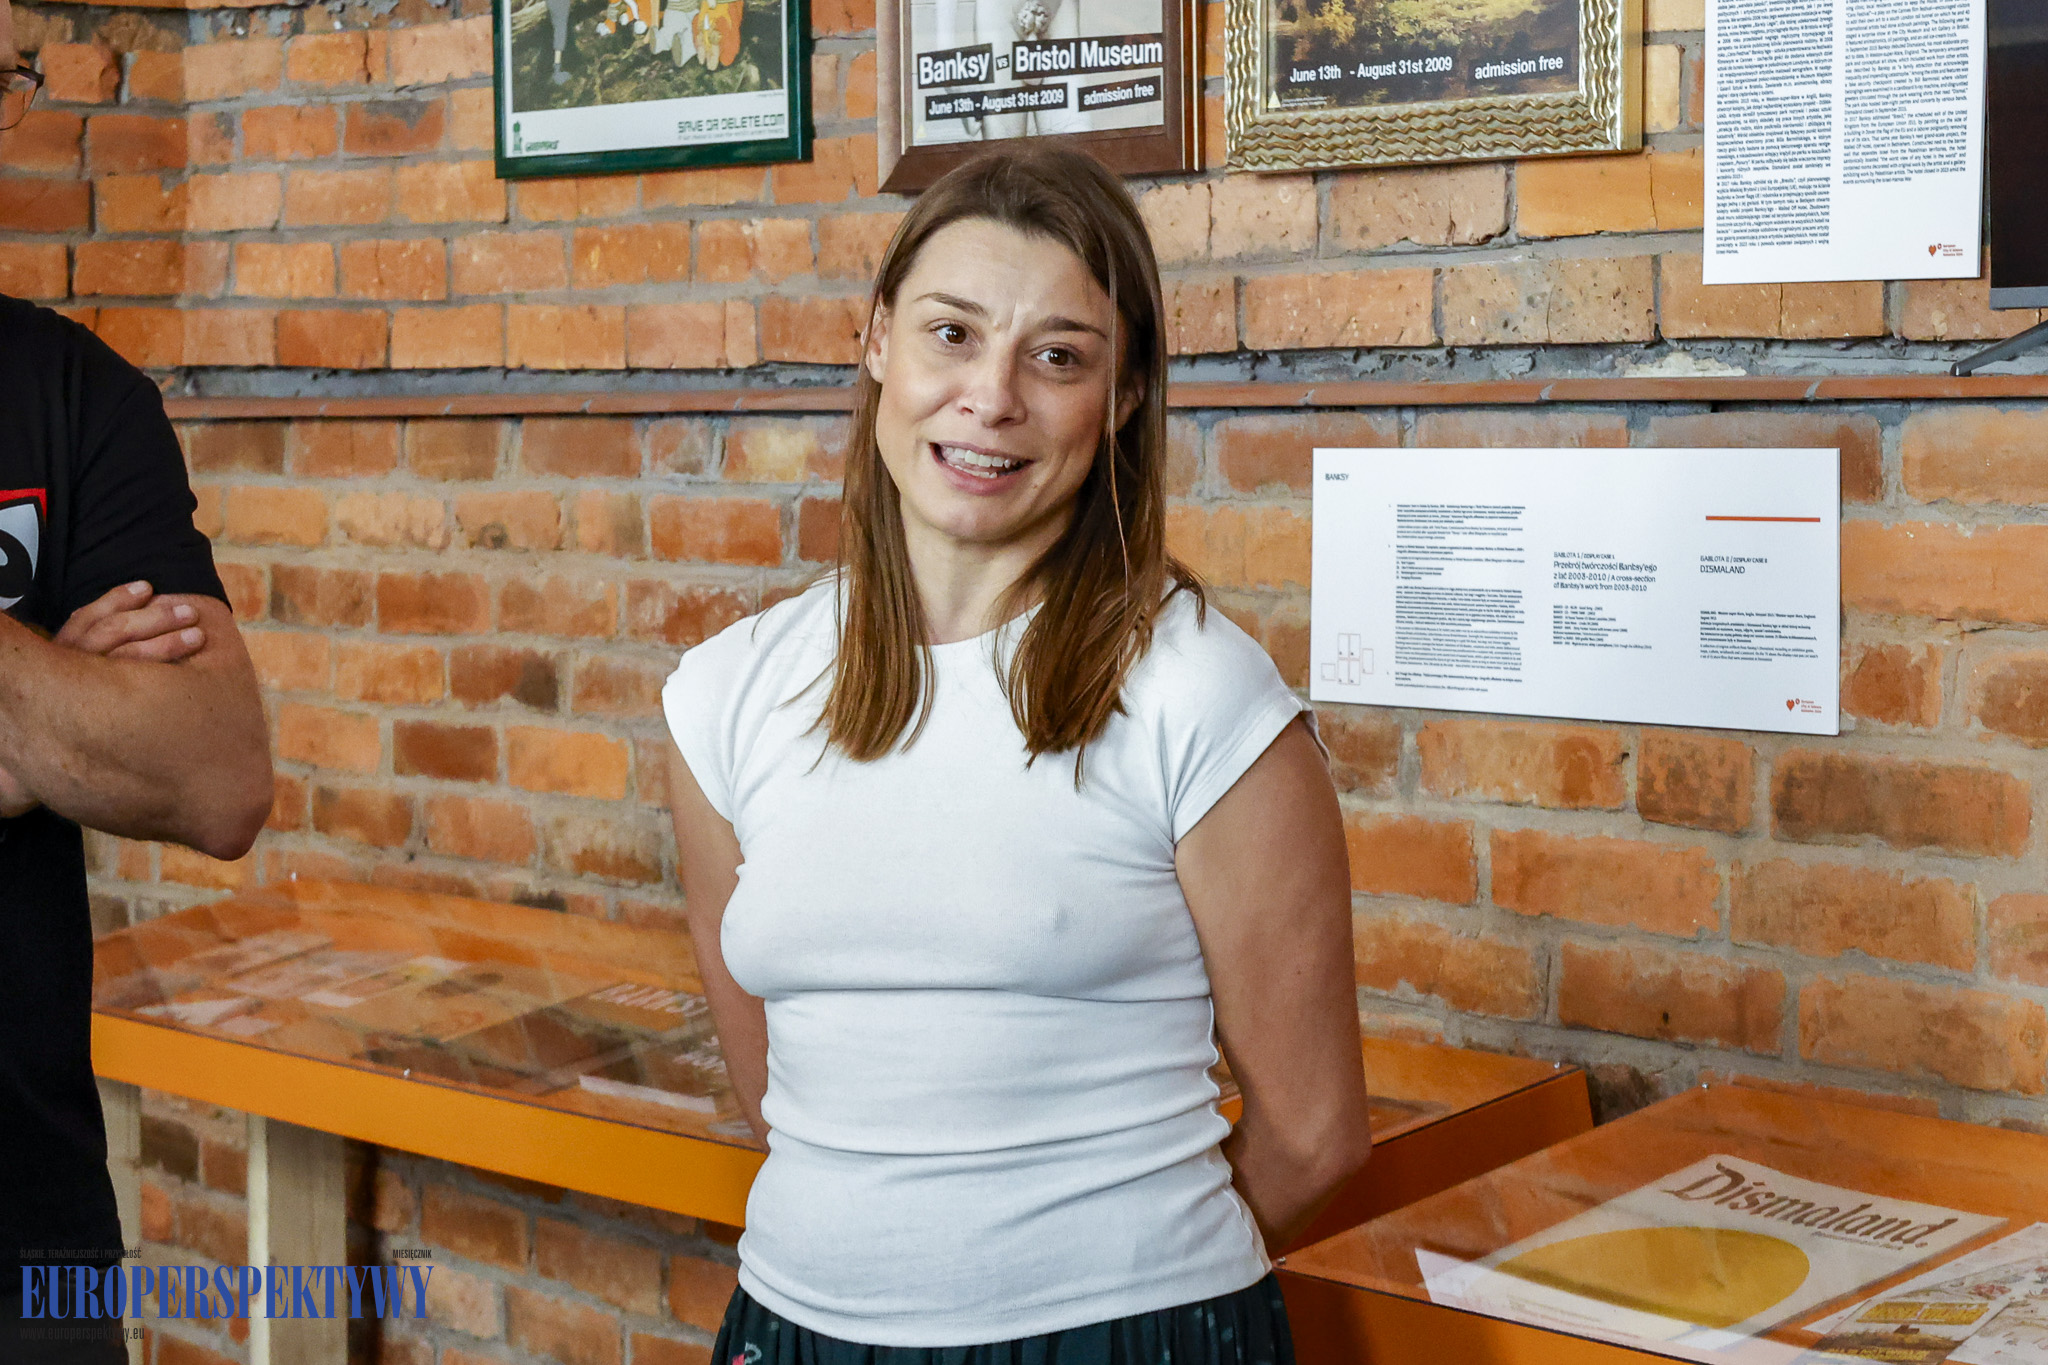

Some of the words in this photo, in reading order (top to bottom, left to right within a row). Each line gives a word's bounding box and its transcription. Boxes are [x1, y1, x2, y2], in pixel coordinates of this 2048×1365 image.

[918, 51, 992, 86] Banksy
[996, 57, 1009, 70] vs
[1015, 42, 1076, 74] Bristol
[1080, 40, 1164, 69] Museum
[1290, 67, 1317, 84] June
[1318, 66, 1342, 81] 13th
[1357, 60, 1397, 79] August
[1398, 59, 1424, 76] 31st
[1425, 56, 1453, 73] 2009
[1474, 61, 1536, 80] admission
[1538, 55, 1564, 73] free
[928, 101, 953, 117] June
[953, 99, 975, 114] 13th
[981, 93, 1016, 112] August
[1017, 91, 1039, 107] 31st
[1040, 88, 1064, 105] 2009
[1083, 88, 1133, 106] admission
[1134, 84, 1155, 99] free
[678, 119, 704, 134] SAVE
[721, 113, 786, 130] DELETE.COM
[1324, 473, 1350, 481] BANKSY
[1568, 572, 1606, 580] 2003-2010
[1699, 564, 1745, 573] DISMALAND
[1613, 583, 1647, 591] 2003-2010
